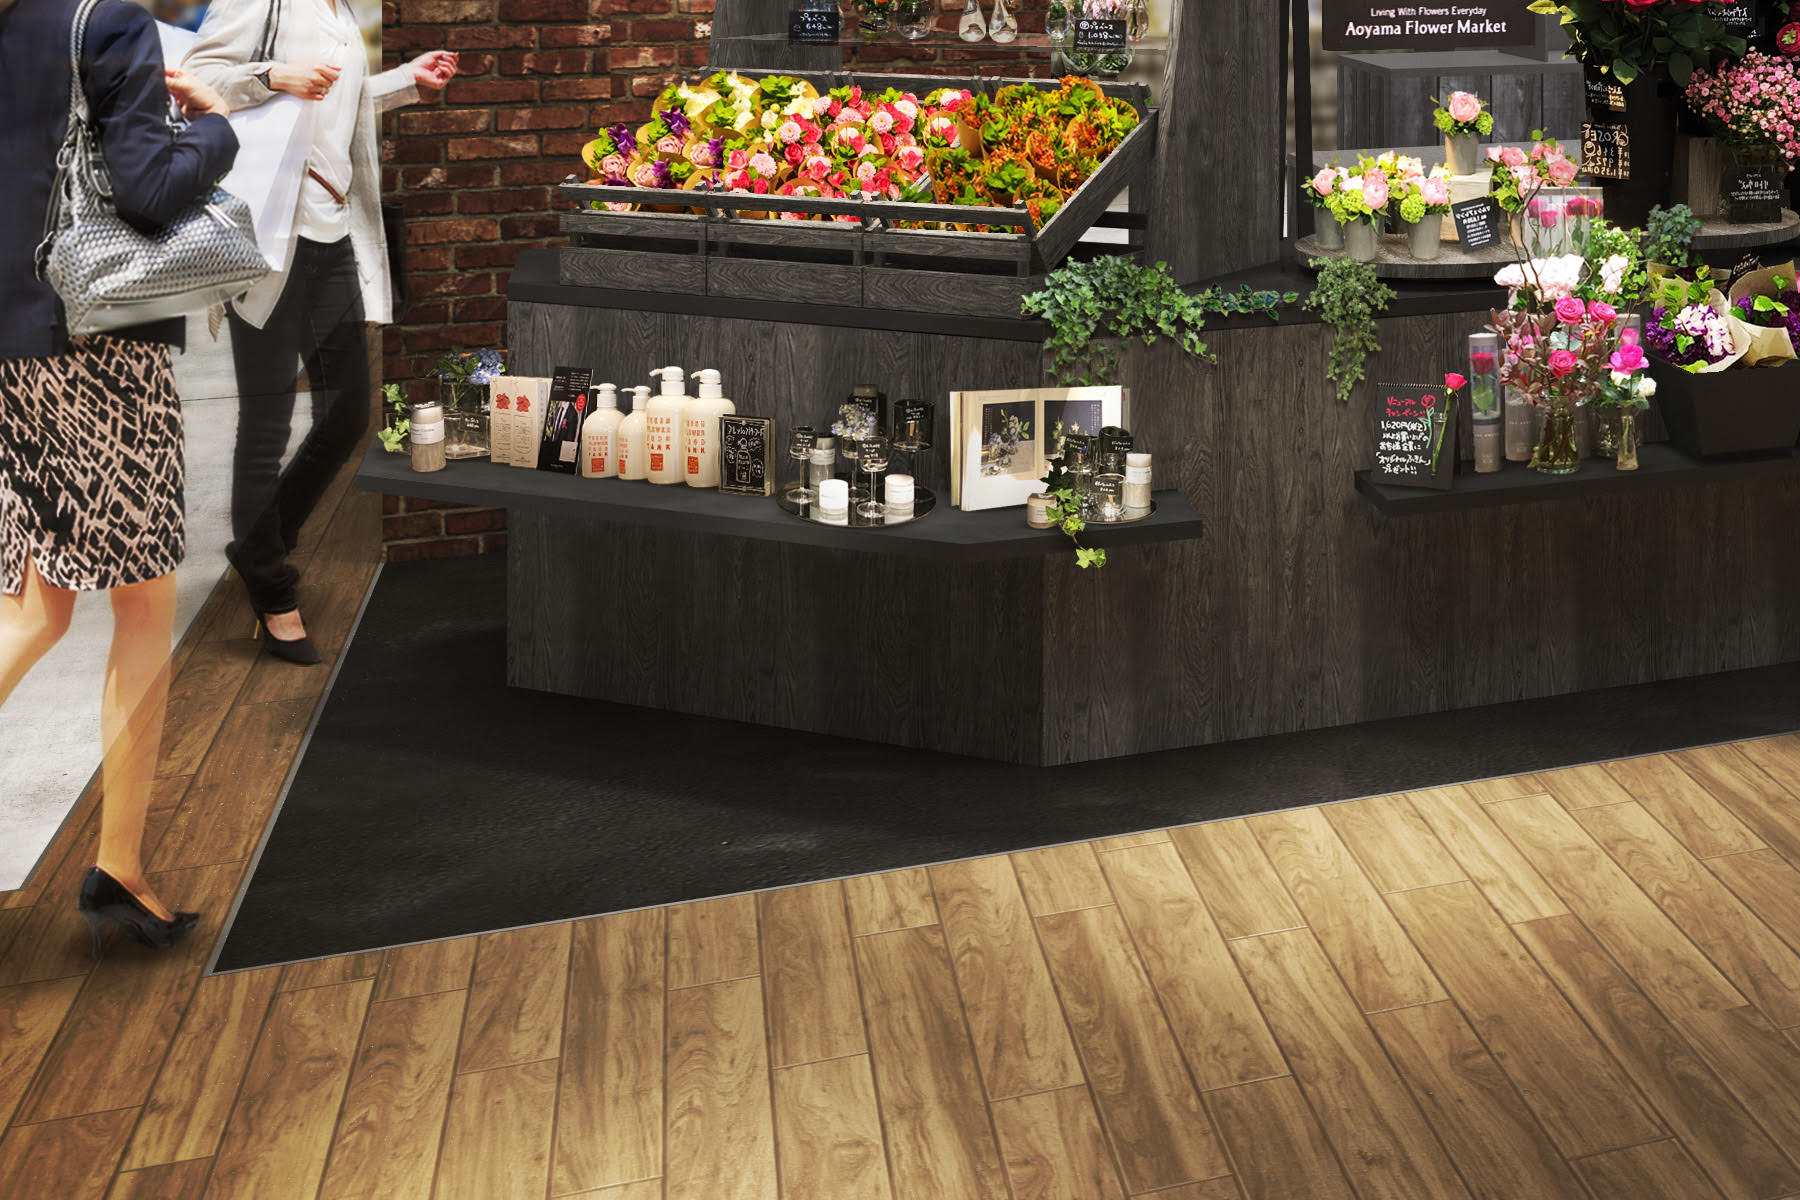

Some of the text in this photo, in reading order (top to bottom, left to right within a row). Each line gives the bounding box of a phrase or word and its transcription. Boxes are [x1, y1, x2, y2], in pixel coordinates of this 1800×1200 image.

[1370, 5, 1487, 18] Living With Flowers Everyday
[1345, 18, 1508, 39] Aoyama Flower Market
